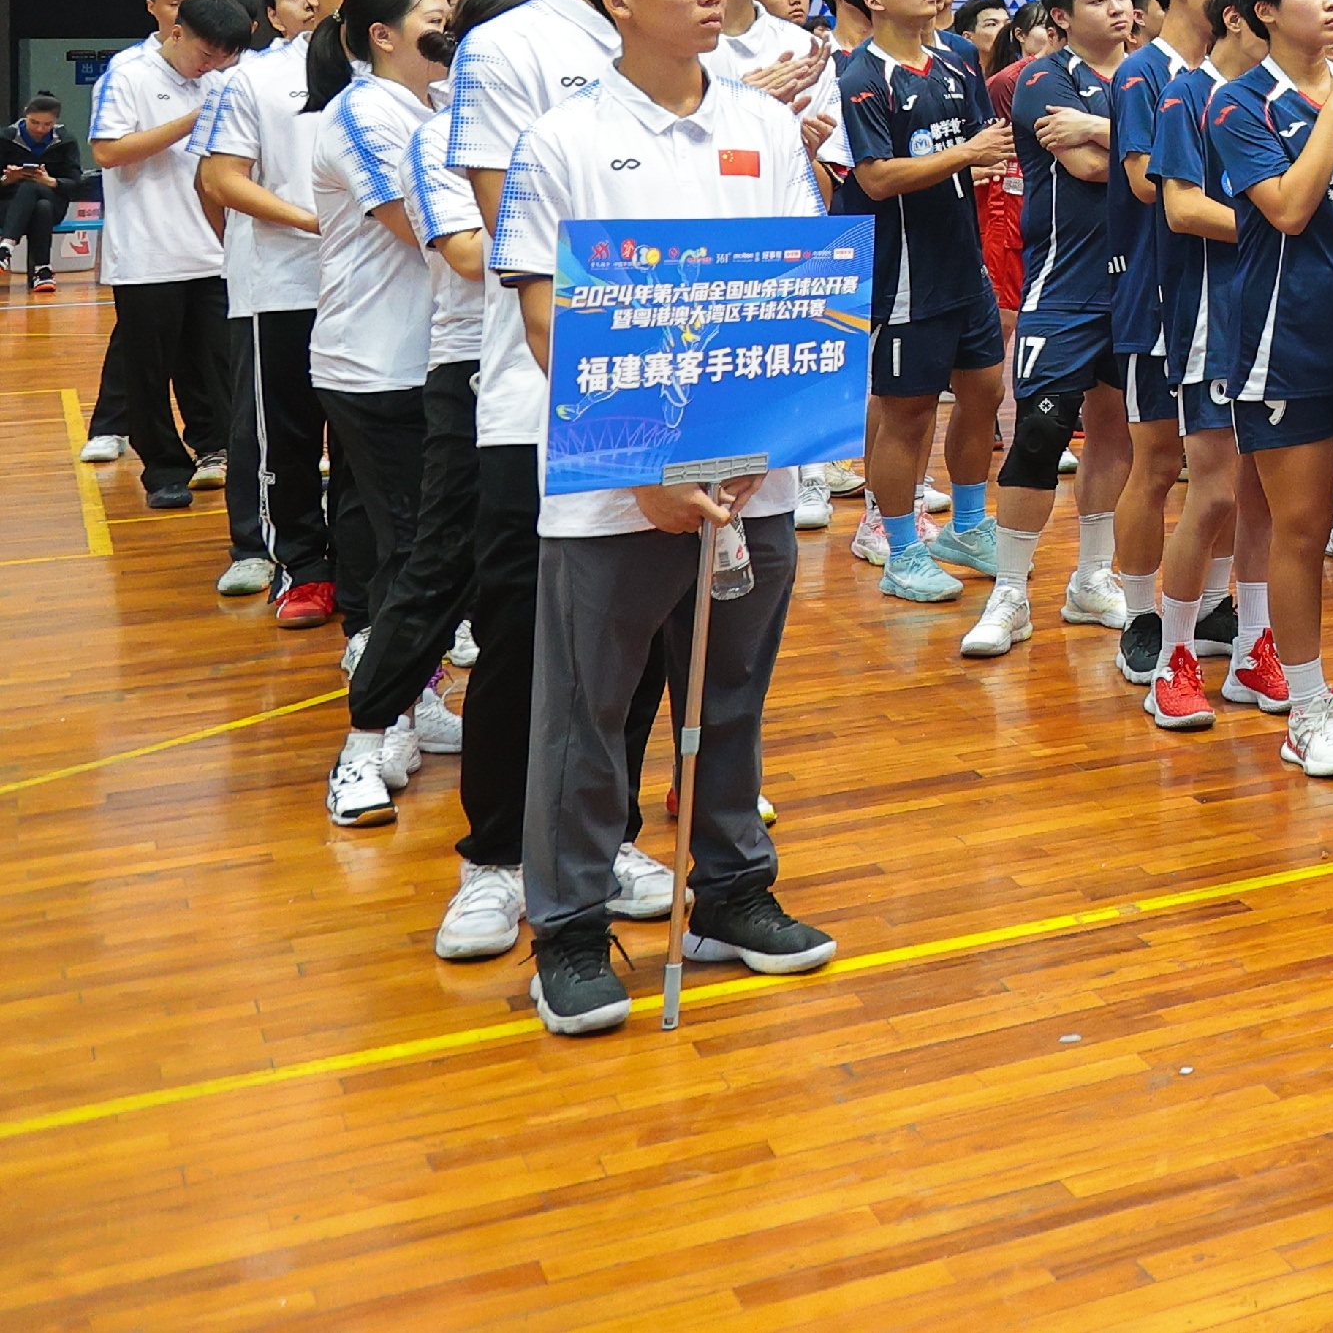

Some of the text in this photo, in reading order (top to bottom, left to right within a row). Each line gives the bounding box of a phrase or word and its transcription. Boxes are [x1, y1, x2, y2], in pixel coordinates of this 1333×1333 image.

[570, 275, 859, 308] 2024年第六届全国业余手球公开赛
[610, 299, 827, 330] 暨粤港澳大湾区手球公开赛
[577, 340, 846, 393] 福建赛客手球俱乐部
[1018, 336, 1046, 379] 17
